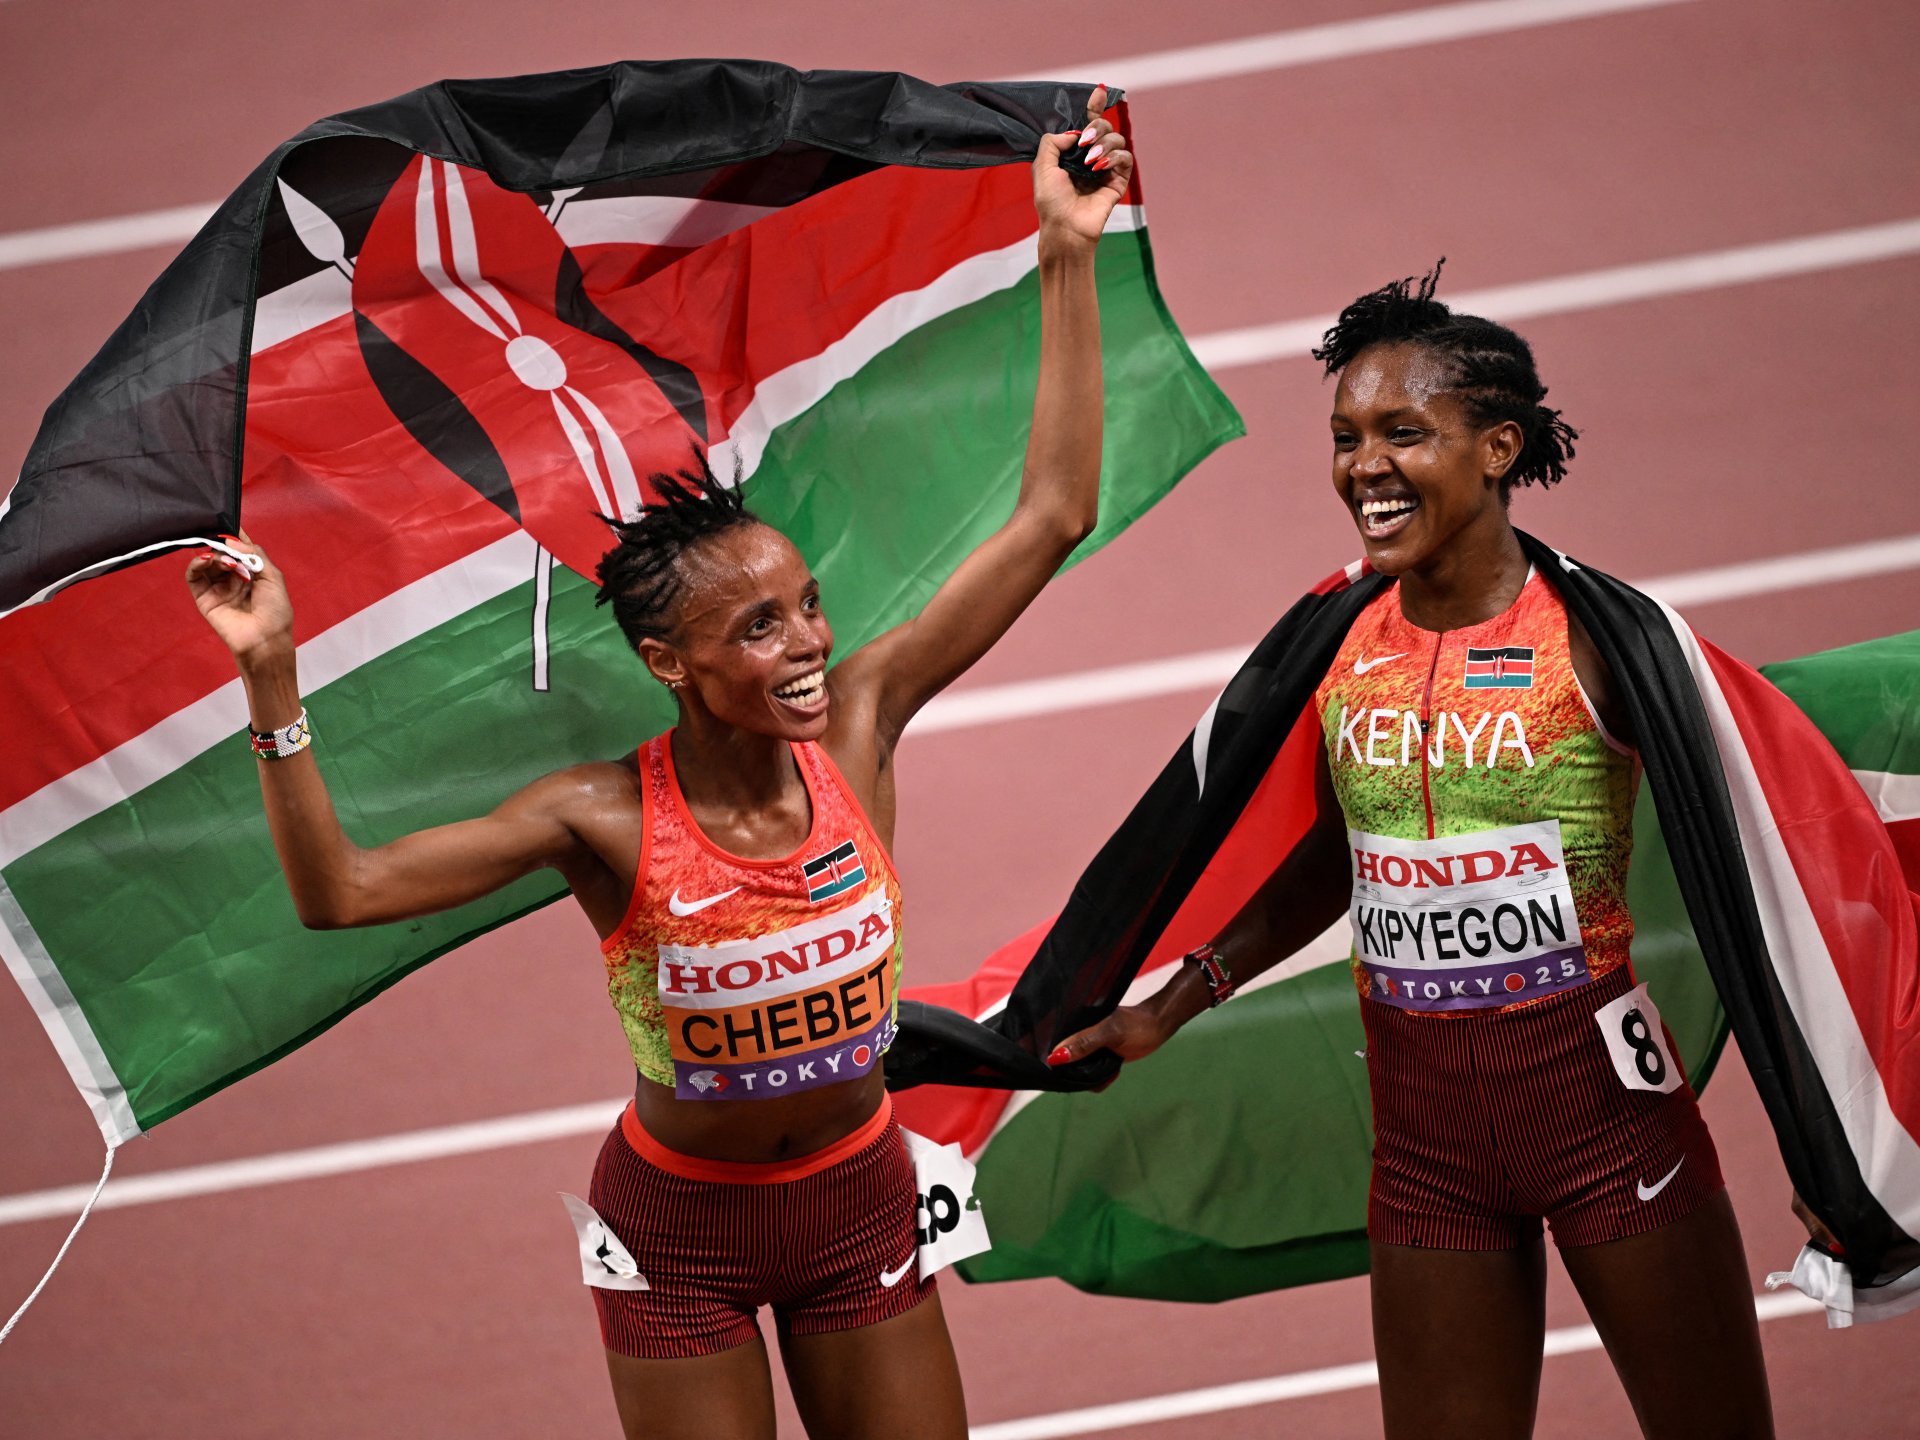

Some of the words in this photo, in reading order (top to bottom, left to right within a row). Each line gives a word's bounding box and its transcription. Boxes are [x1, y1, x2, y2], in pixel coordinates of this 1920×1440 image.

[1337, 706, 1535, 768] KENYA
[1354, 842, 1558, 888] HONDA
[665, 913, 890, 993] HONDA
[1357, 894, 1567, 961] KIPYEGON
[1535, 957, 1576, 986] 25
[681, 957, 888, 1058] CHEBET
[1621, 1008, 1666, 1086] 8
